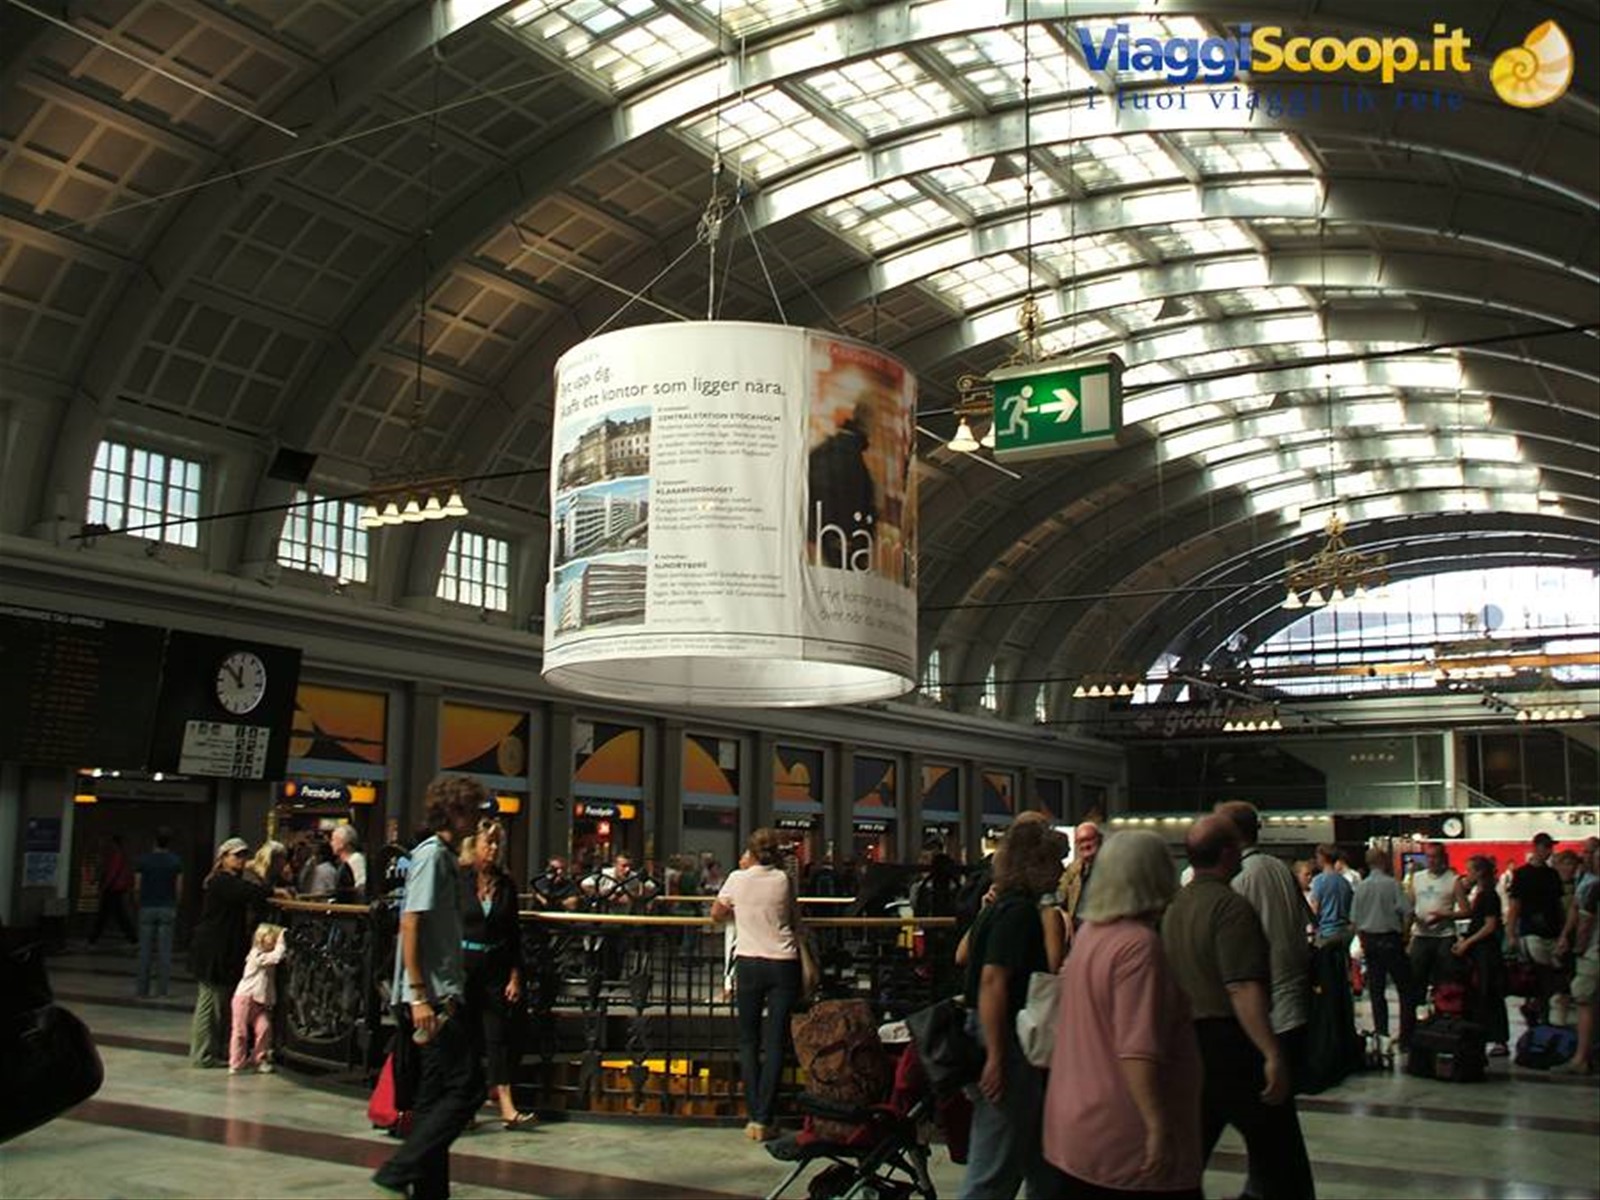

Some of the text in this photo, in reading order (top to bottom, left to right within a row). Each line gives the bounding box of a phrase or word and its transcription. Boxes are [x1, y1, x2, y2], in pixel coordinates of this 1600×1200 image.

[602, 383, 648, 402] kontor
[653, 380, 687, 396] som
[693, 377, 740, 397] ligger
